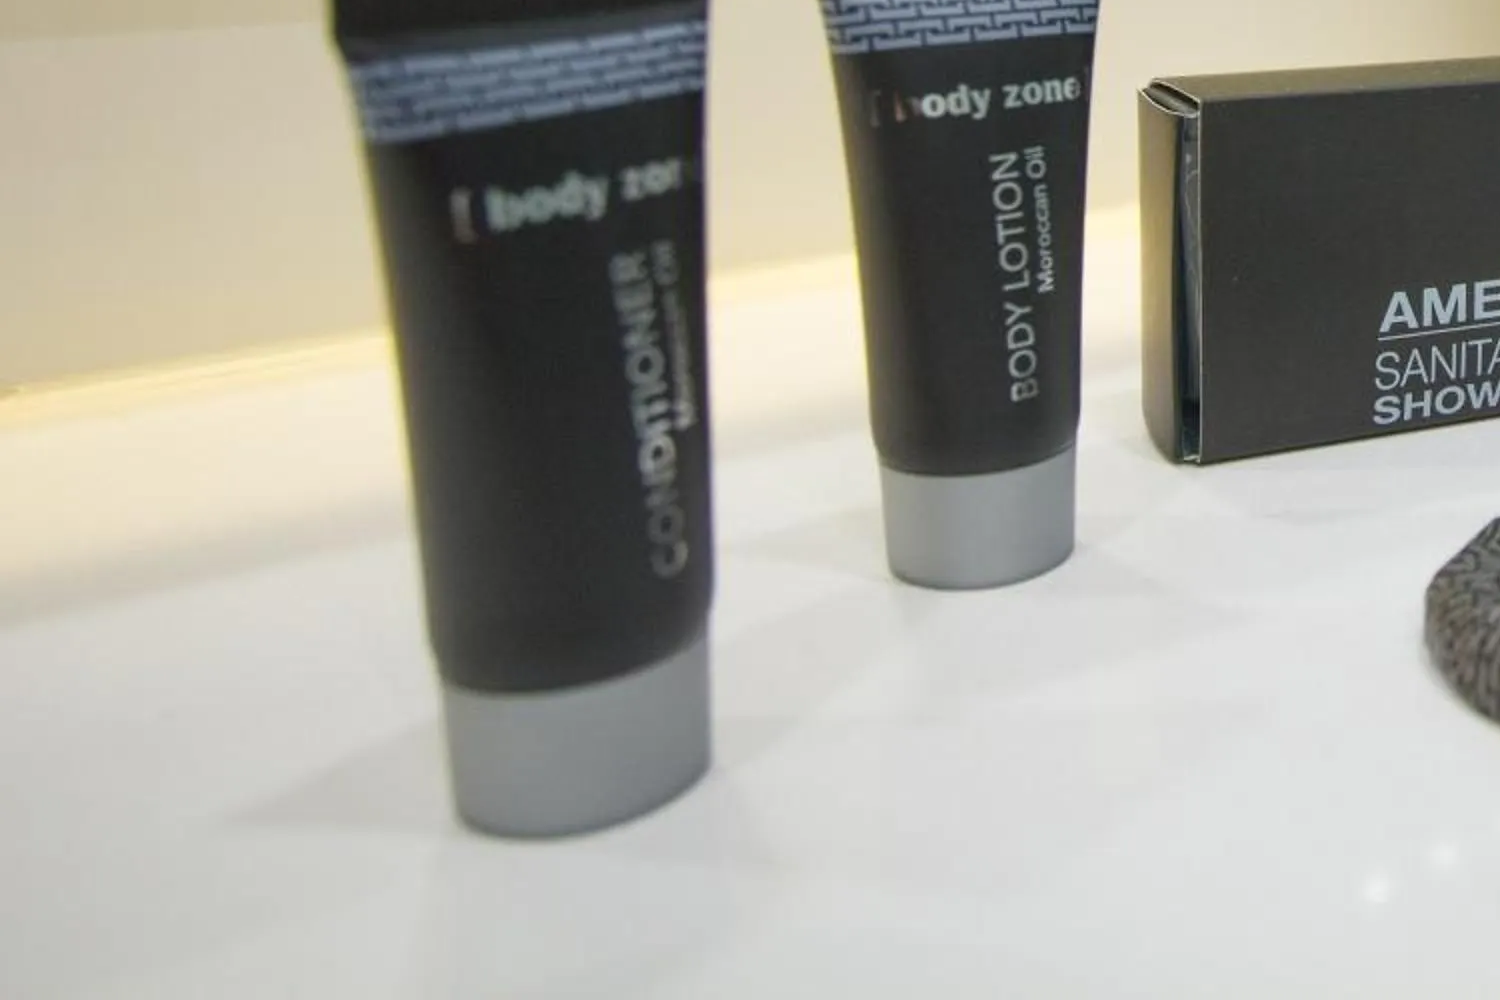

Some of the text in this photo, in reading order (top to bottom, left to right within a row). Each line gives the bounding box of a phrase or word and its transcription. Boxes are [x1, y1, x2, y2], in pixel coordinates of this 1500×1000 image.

[988, 150, 1040, 402] BODY LOTION
[1023, 144, 1056, 294] Moroccan Oil
[608, 251, 689, 580] CONDITIONER
